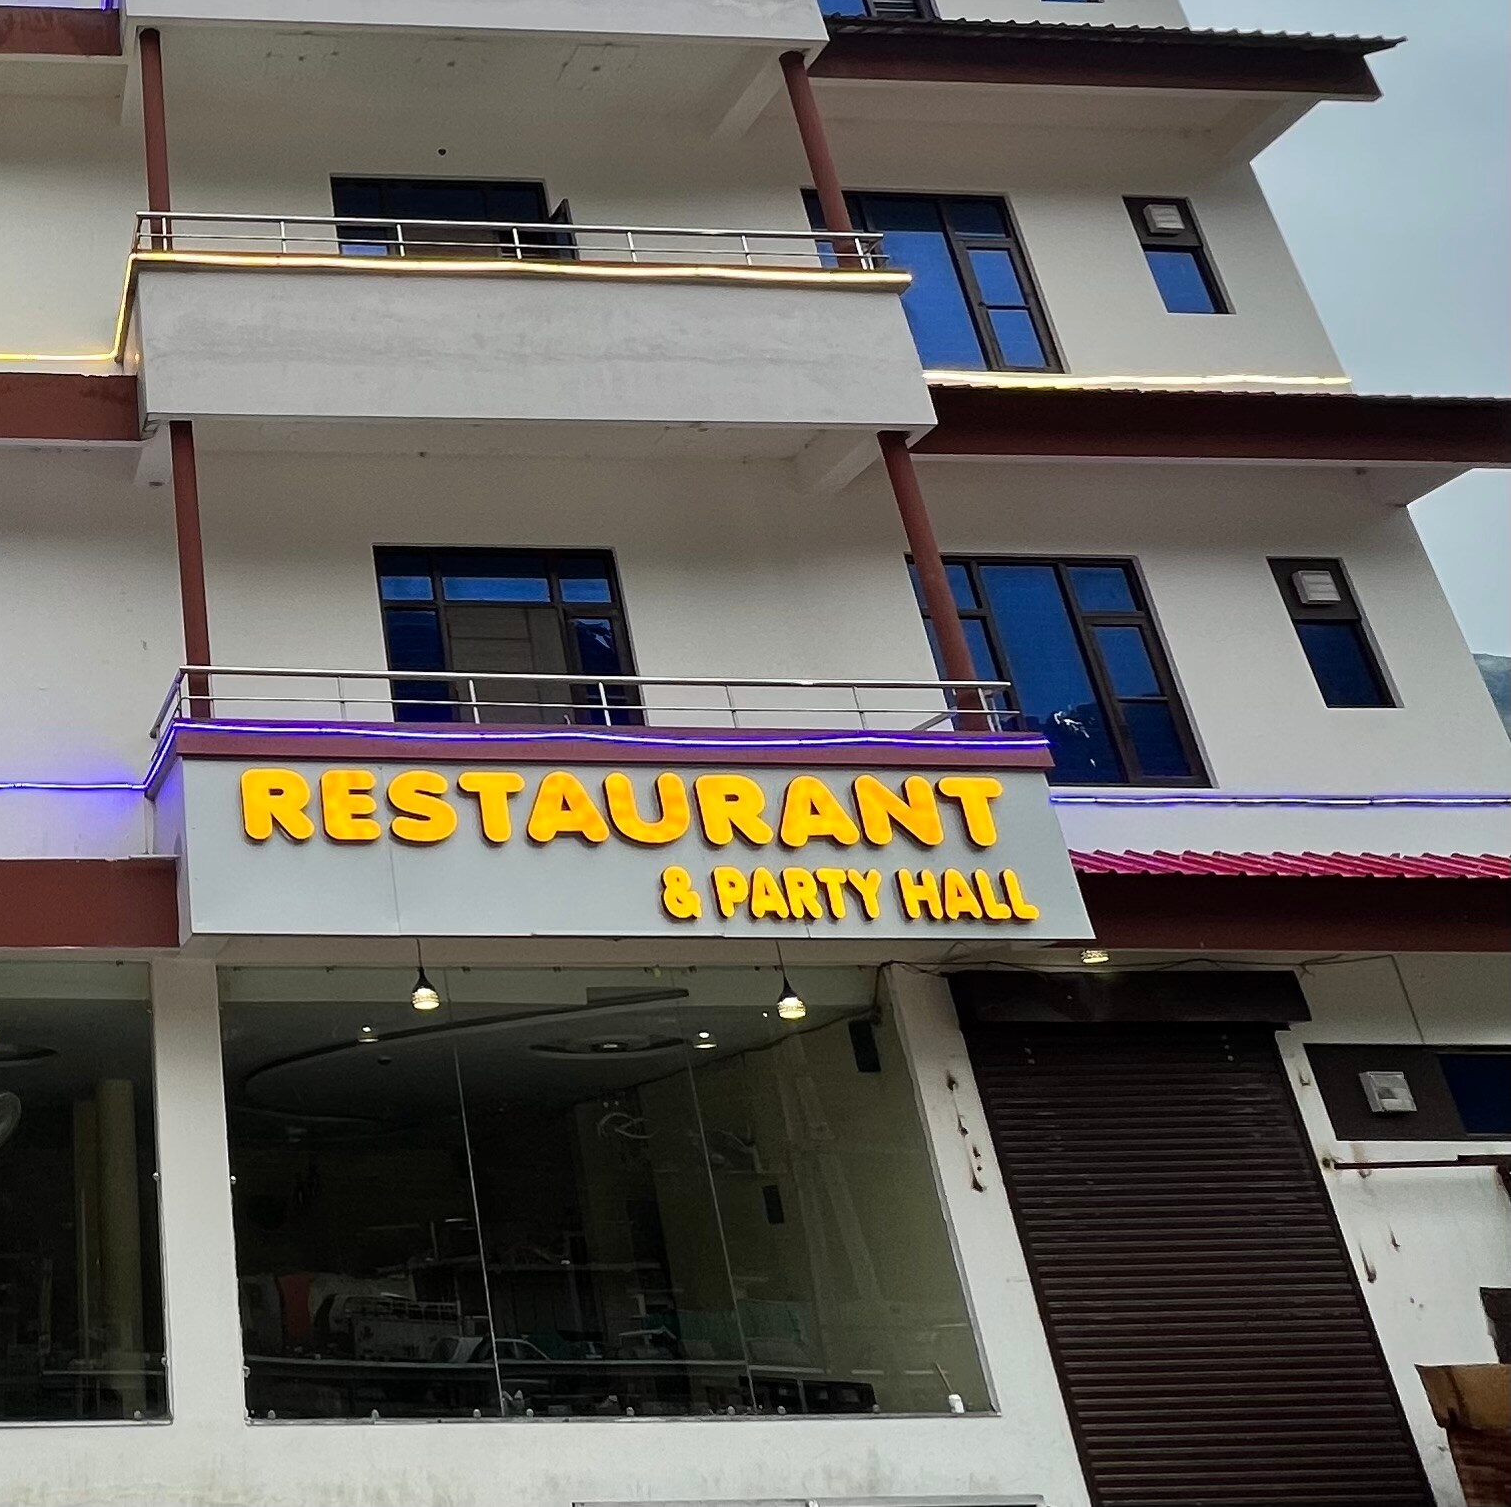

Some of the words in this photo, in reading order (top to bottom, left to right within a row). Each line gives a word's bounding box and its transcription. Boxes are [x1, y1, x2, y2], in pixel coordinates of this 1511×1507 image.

[238, 767, 1003, 850] RESTAURANT
[661, 866, 703, 920] &
[712, 866, 883, 921] PARTY
[897, 869, 1040, 922] HALL
